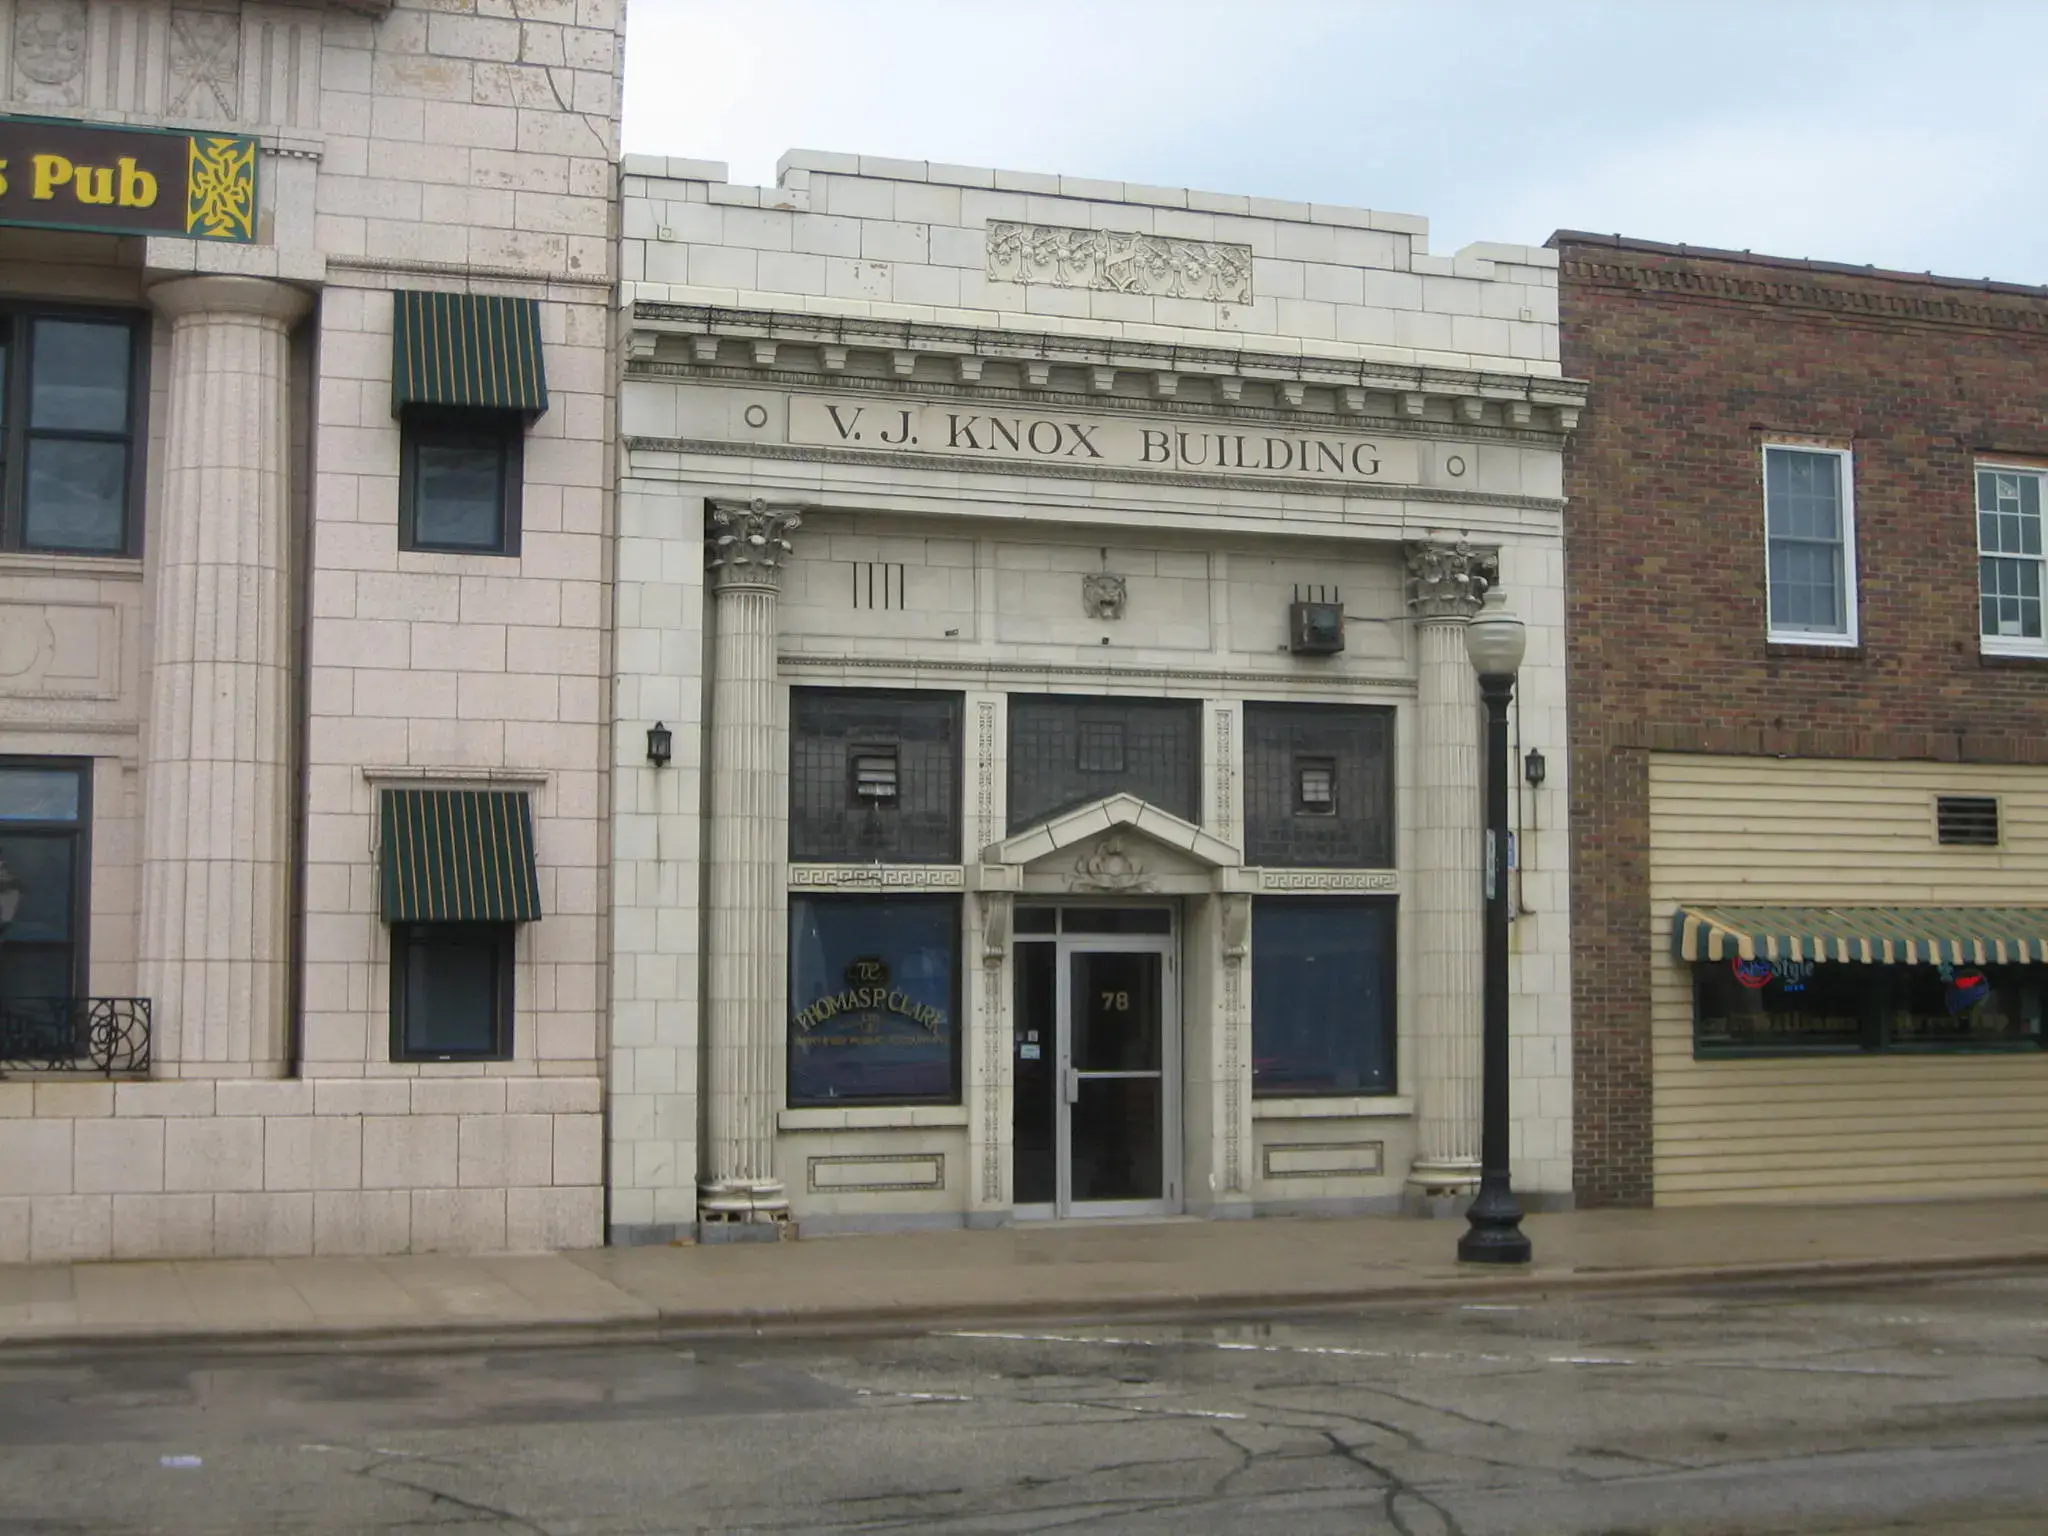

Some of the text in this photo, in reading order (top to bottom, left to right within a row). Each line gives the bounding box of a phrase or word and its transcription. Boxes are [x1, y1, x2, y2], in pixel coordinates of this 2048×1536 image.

[32, 154, 158, 208] Pub
[826, 404, 1382, 476] V. J. KNOX BUILDING
[793, 987, 871, 1033] THOMAS
[888, 991, 948, 1036] CLARK
[1101, 991, 1129, 1011] 78
